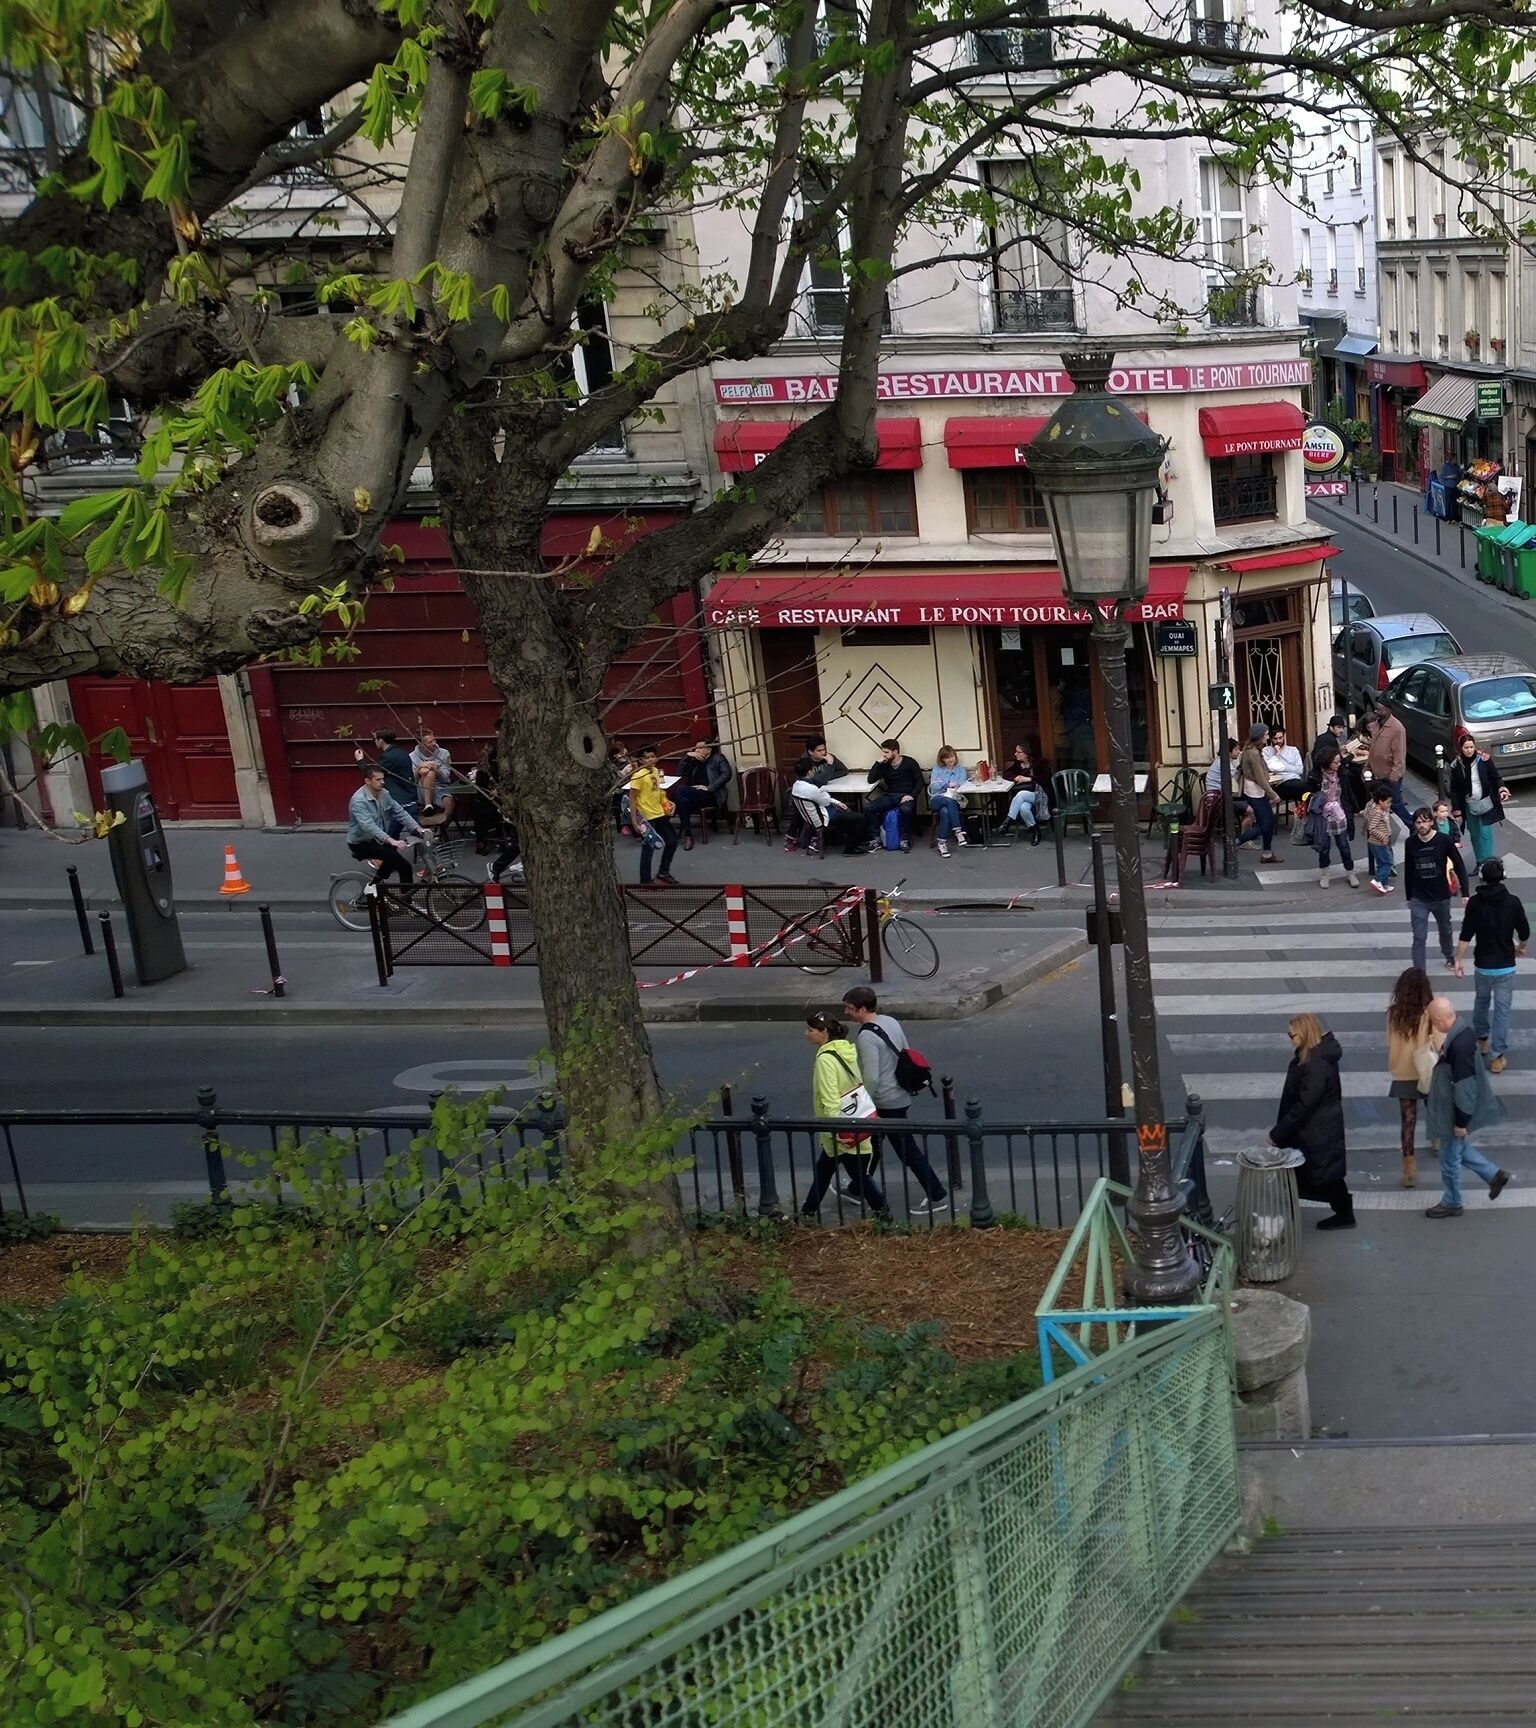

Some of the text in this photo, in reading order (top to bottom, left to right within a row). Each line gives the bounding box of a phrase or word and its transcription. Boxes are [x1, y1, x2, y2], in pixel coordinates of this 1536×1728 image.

[877, 372, 1062, 396] RESTAURANT
[1108, 370, 1183, 391] OTEL
[1190, 362, 1309, 389] LE PONT TOURNANT
[1224, 438, 1302, 453] LE PONT TOURNANT
[1304, 441, 1335, 450] AMSTEL
[1304, 483, 1345, 495] BAR
[778, 608, 900, 623] RESTAURANT
[919, 607, 946, 622] LE
[951, 607, 1005, 622] PONT
[1141, 602, 1179, 619] BAR
